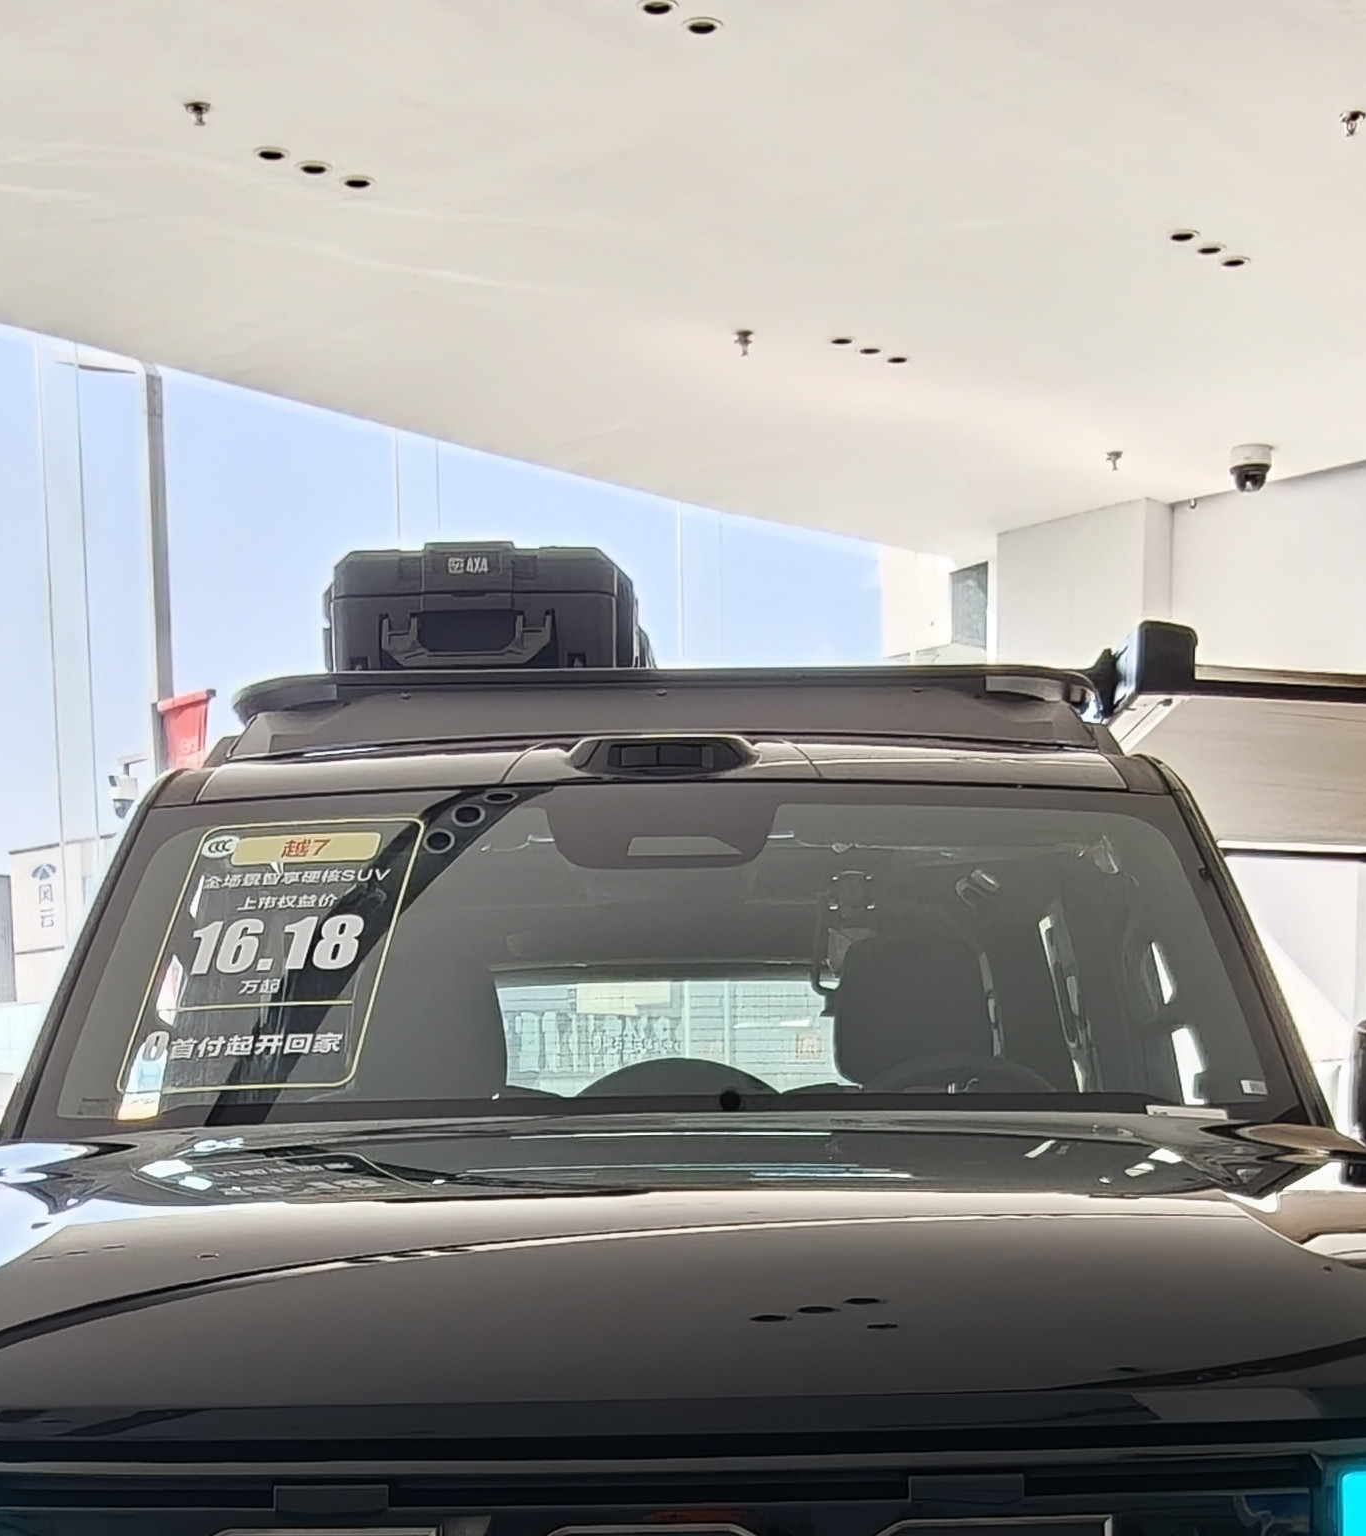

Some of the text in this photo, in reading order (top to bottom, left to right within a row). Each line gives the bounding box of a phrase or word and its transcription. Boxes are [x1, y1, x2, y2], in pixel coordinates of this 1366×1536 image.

[280, 838, 331, 858] 越7
[38, 883, 55, 928] 风云
[237, 893, 338, 911] 上市权益价
[190, 913, 365, 976] 16.18
[238, 978, 281, 995] 万起
